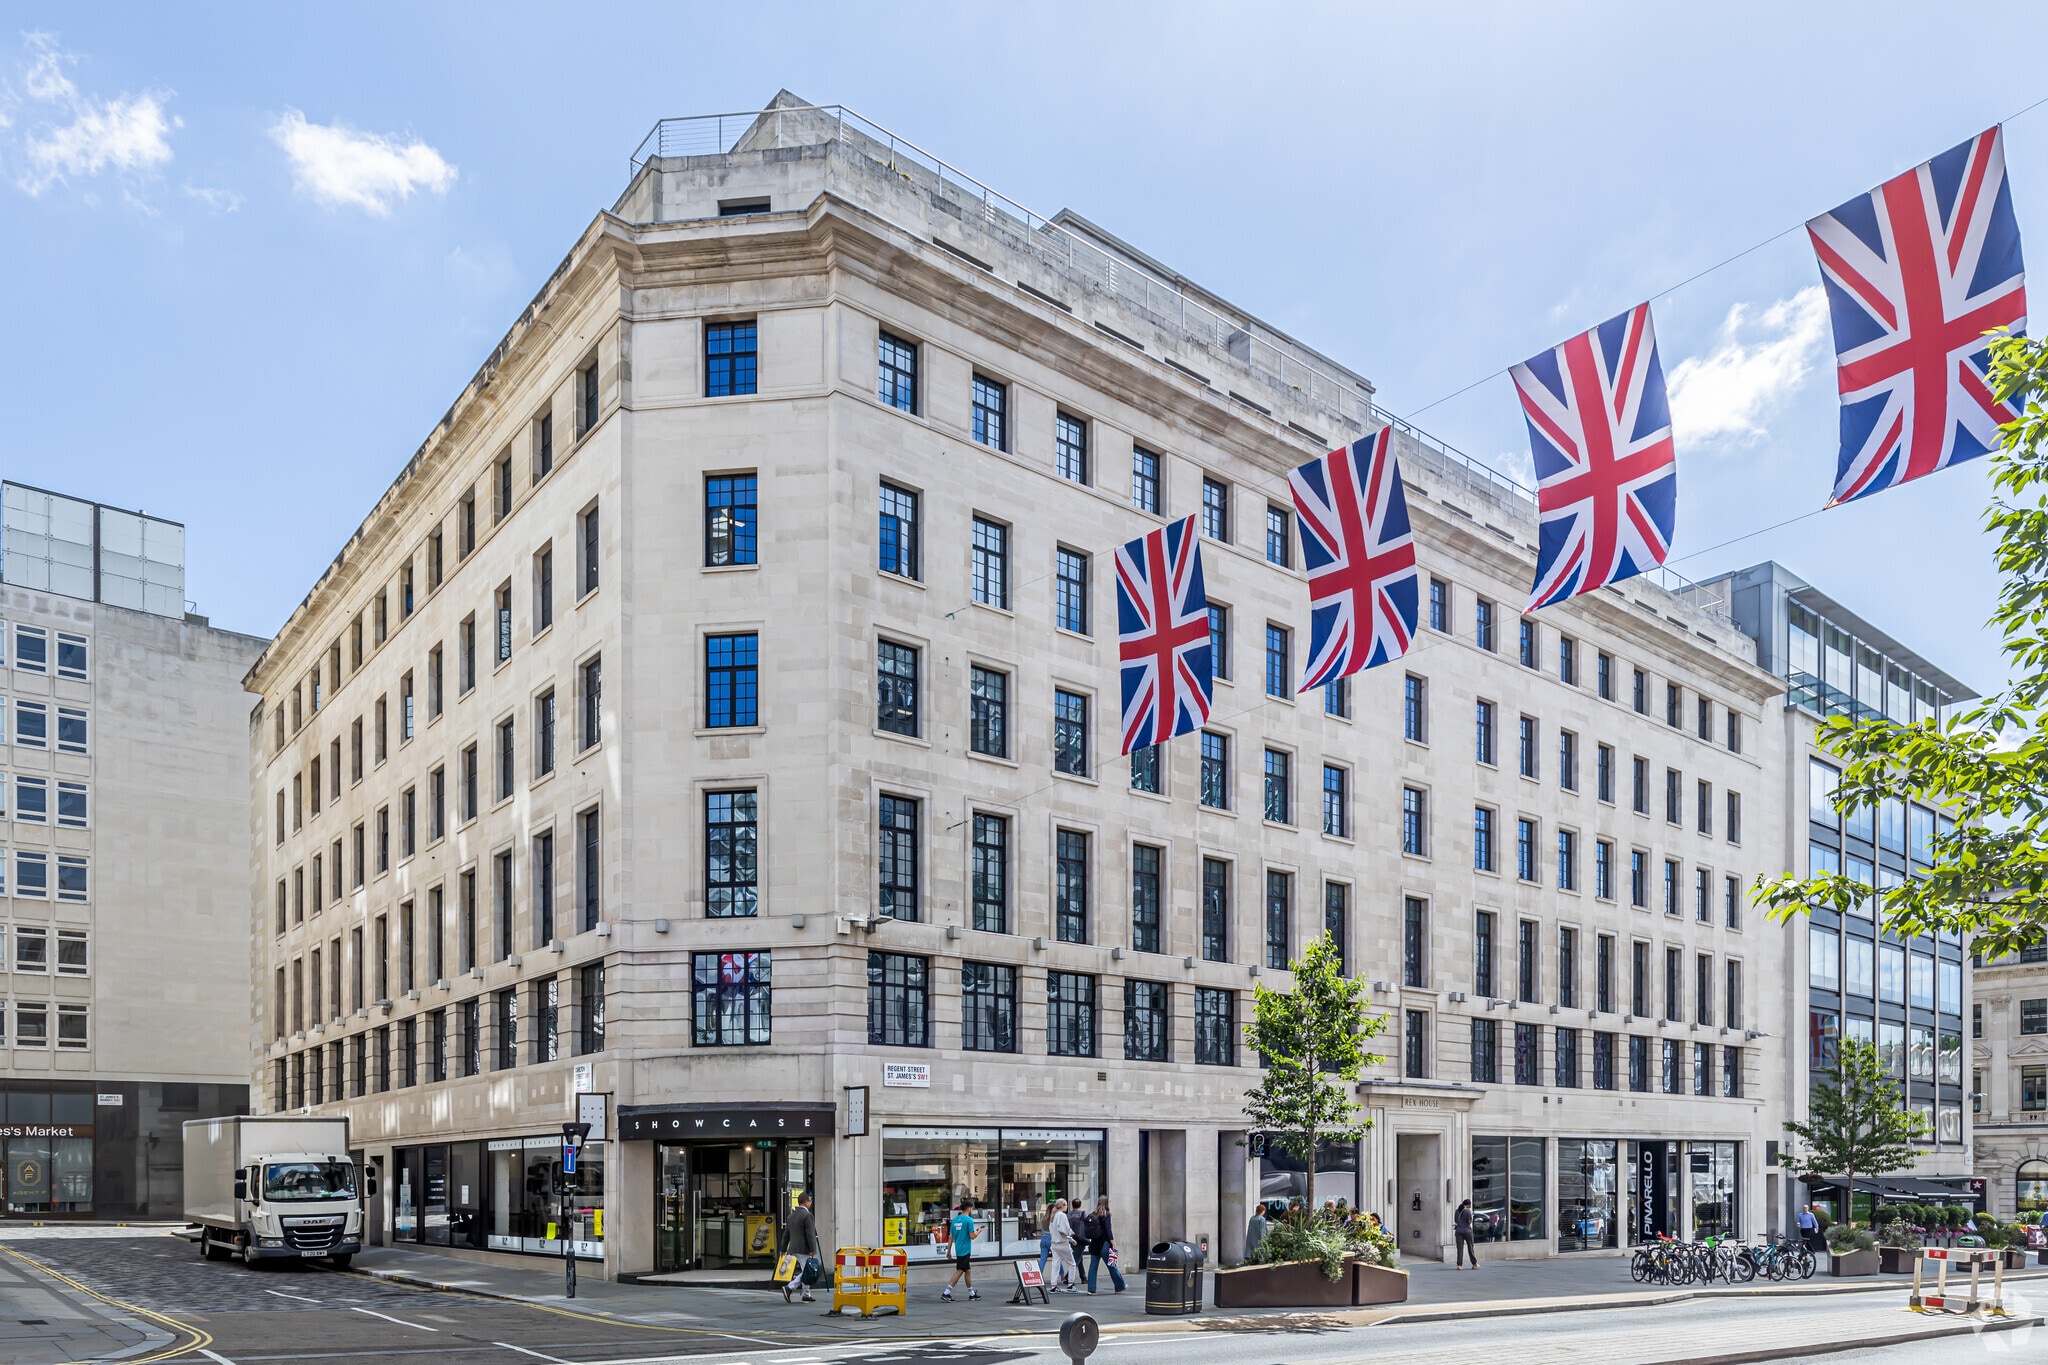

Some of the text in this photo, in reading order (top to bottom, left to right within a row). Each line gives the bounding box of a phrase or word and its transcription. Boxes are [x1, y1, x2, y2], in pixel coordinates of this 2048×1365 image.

[1405, 1098, 1439, 1107] REX HOUSE
[635, 1119, 811, 1129] SHOWCASE
[26, 1126, 73, 1136] Market
[1644, 1151, 1653, 1235] PINARELLO
[1081, 1324, 1086, 1334] 1
